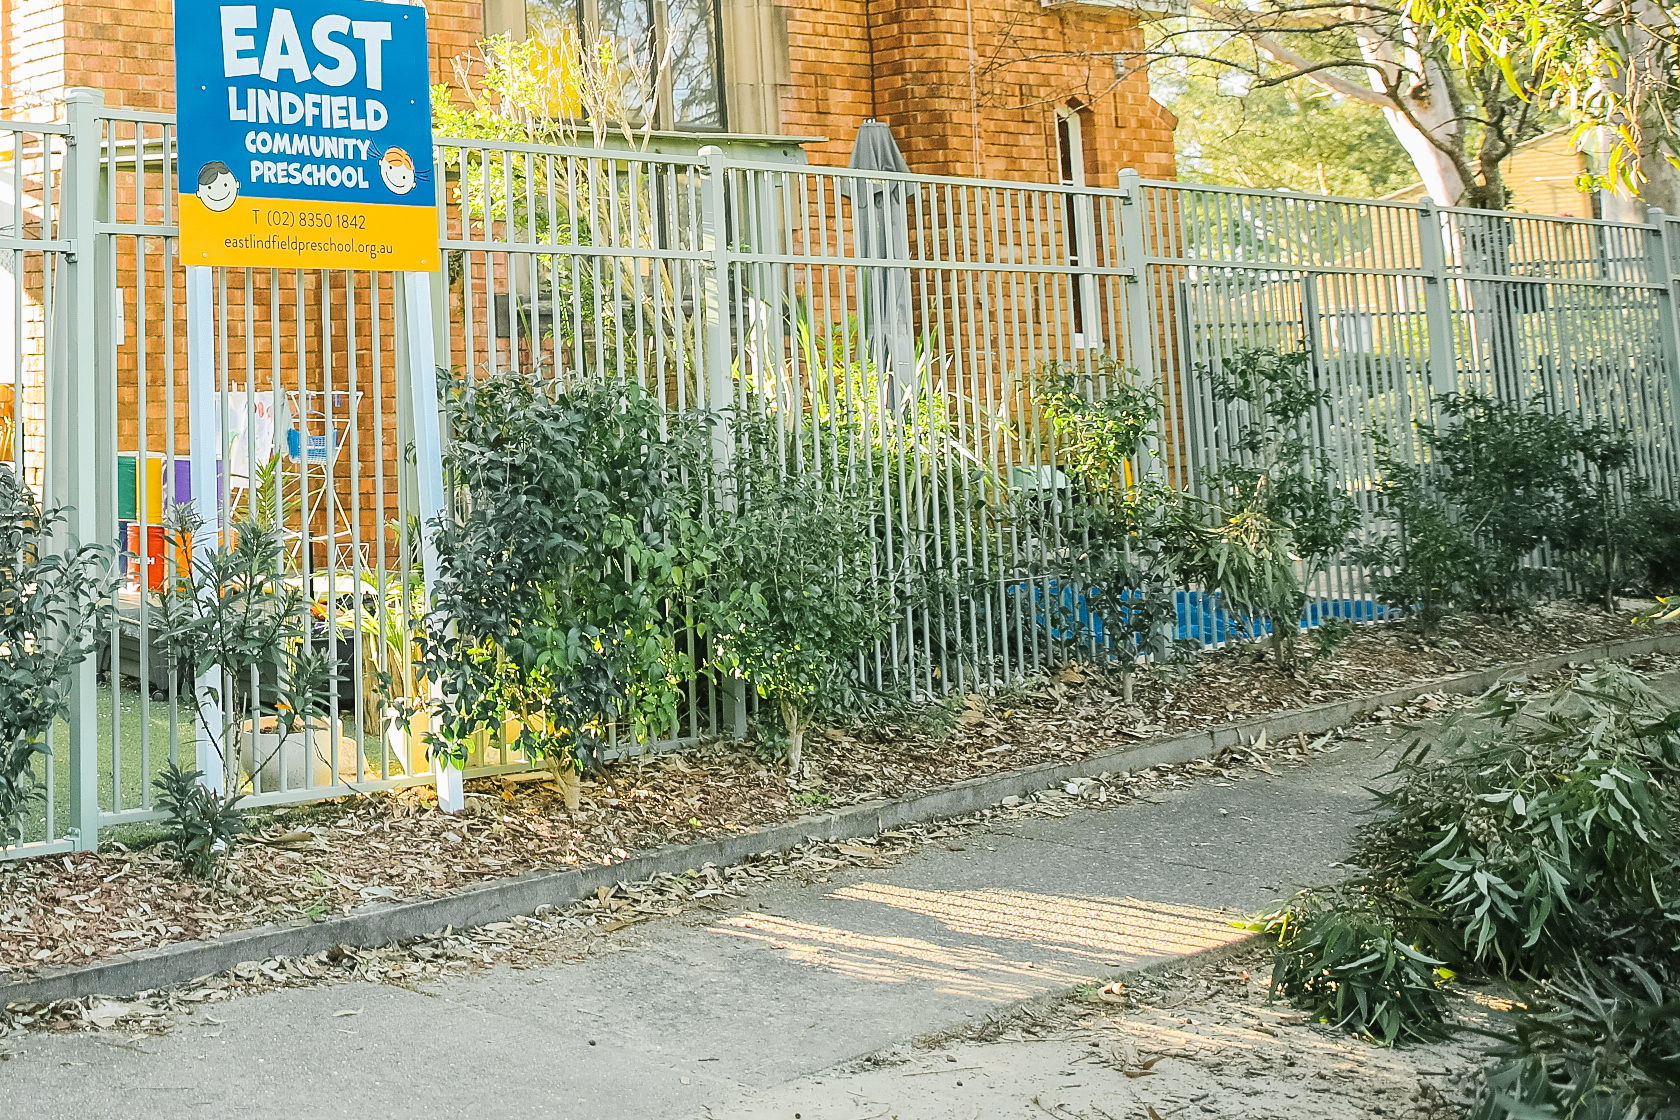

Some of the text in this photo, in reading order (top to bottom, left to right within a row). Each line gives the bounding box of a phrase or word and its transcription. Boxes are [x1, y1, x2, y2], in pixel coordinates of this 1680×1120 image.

[220, 5, 393, 91] EAST
[227, 86, 389, 132] LINDFIELD
[244, 131, 370, 160] COMMUNITY
[250, 160, 370, 189] PRESCHOOL
[252, 209, 366, 230] T (02) 8350 1842
[224, 234, 393, 259] eastlindfieldpreschool.org.au
